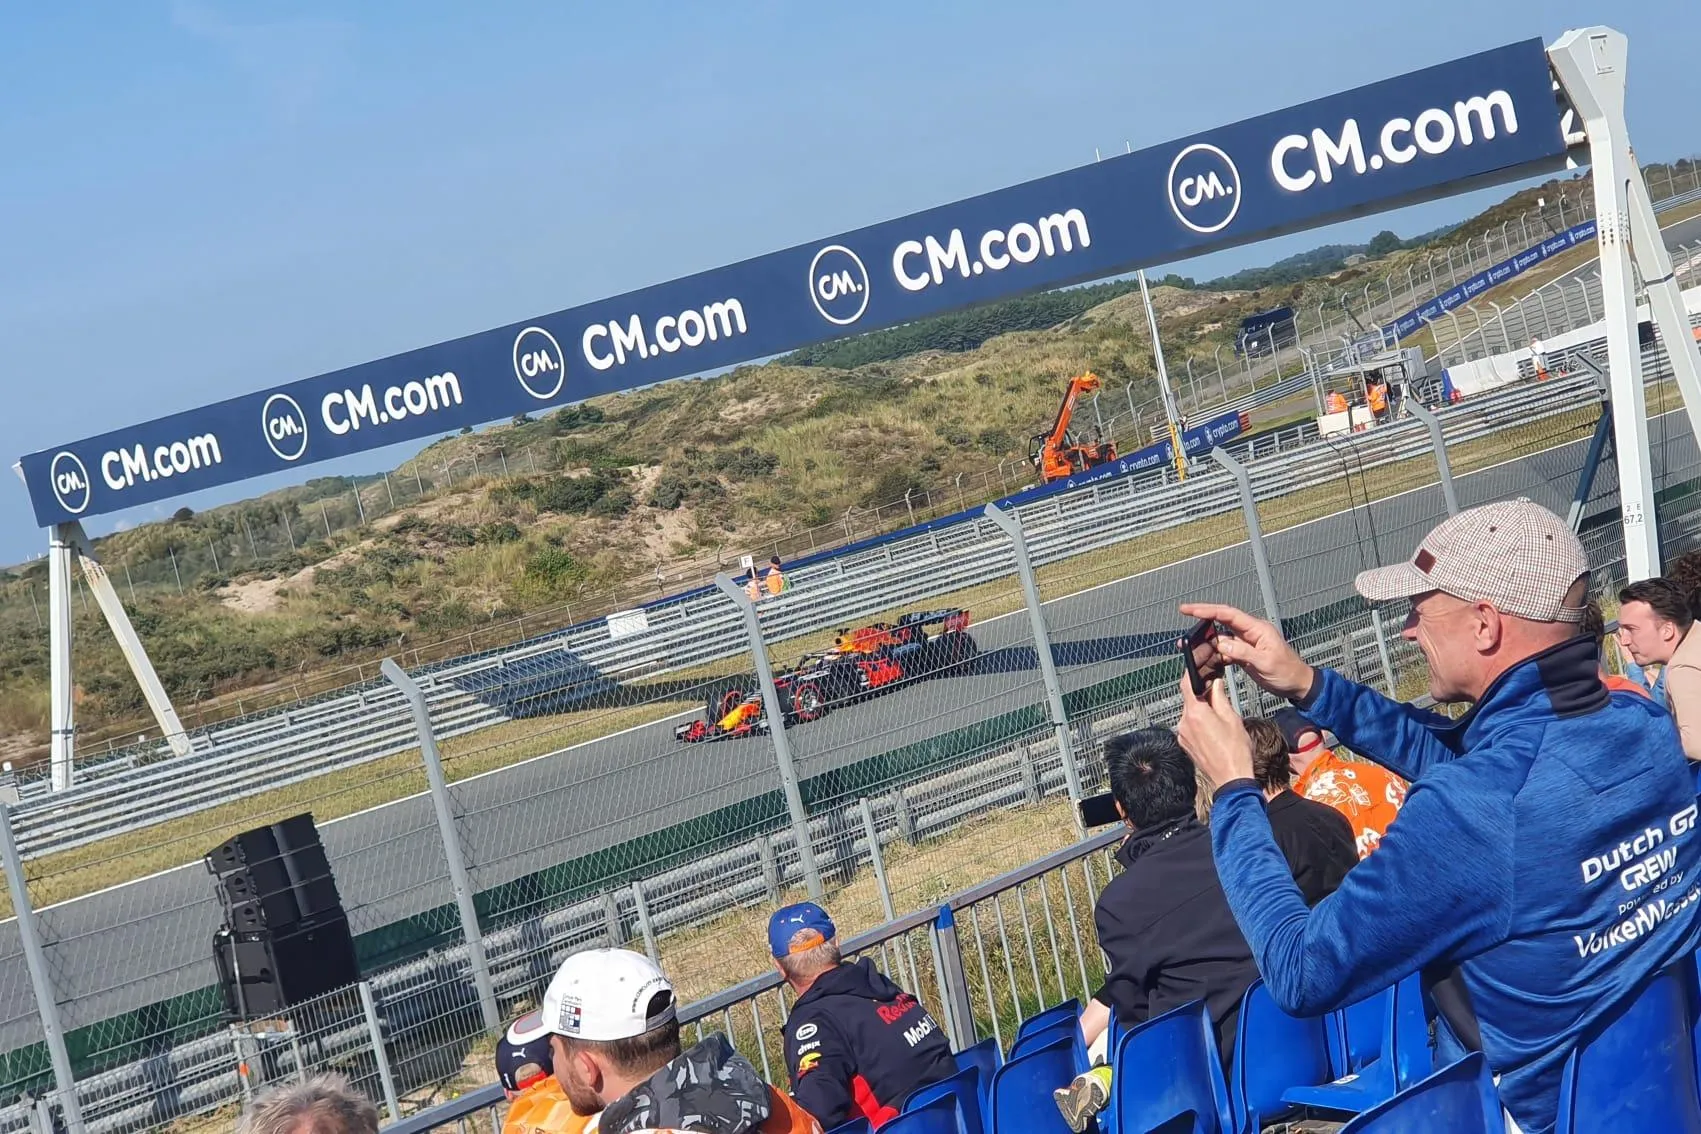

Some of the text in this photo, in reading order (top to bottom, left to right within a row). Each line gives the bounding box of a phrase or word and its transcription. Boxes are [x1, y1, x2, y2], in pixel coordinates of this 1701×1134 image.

[1179, 90, 1518, 208] CM. CM.com
[818, 208, 1091, 301] CM. CM.com
[520, 298, 749, 375] CM. CM.com
[269, 371, 463, 441] CM. CM.com
[1212, 419, 1239, 439] crypto.com
[57, 433, 222, 496] CM. CM.com
[1581, 827, 1664, 884] Dutch
[1620, 846, 1677, 891] CREW
